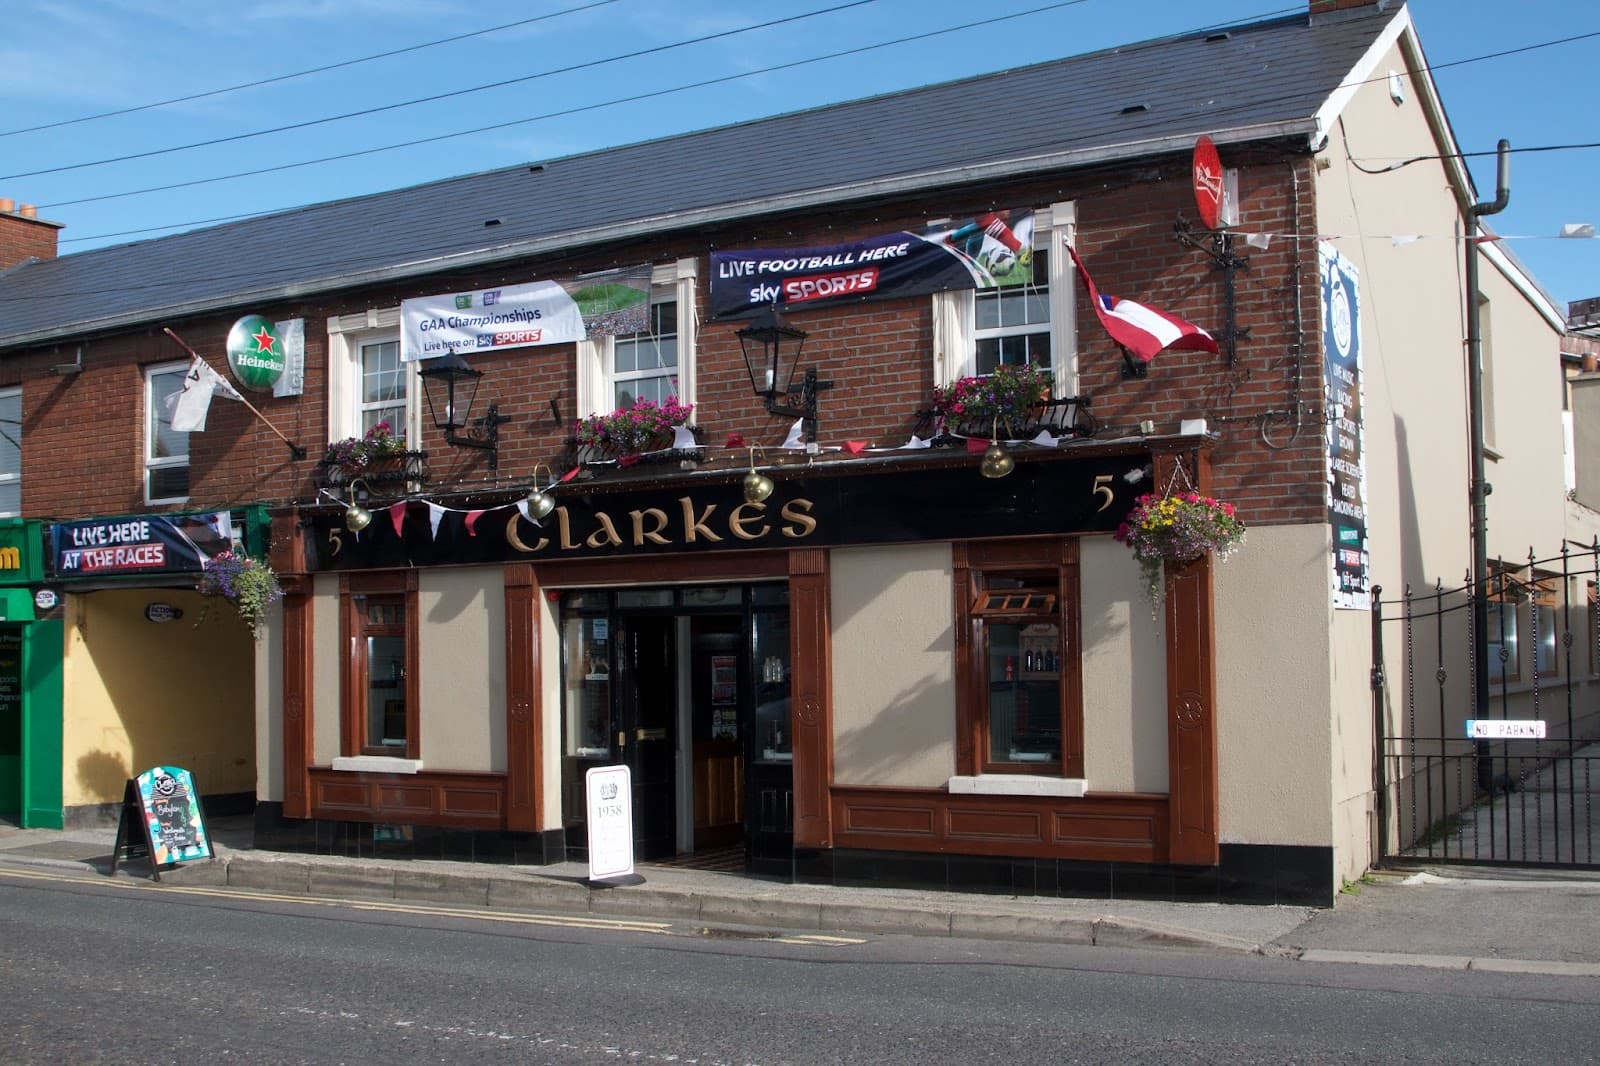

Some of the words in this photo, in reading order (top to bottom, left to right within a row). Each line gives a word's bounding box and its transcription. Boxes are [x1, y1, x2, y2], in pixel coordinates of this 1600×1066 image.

[720, 261, 755, 279] LIVE
[758, 253, 854, 273] FOOTBALL
[858, 243, 910, 262] HERE
[750, 283, 780, 303] sky
[786, 272, 874, 299] SPORTS
[420, 318, 446, 332] GAA
[448, 308, 542, 328] Championships
[424, 343, 441, 352] Live
[442, 339, 461, 349] here
[463, 339, 475, 348] on
[495, 330, 540, 345] SPORTS
[1092, 475, 1114, 512] 5
[73, 525, 107, 546] LIVE
[109, 521, 150, 543] HERE
[329, 528, 342, 557] 5
[63, 552, 81, 570] AT
[84, 550, 113, 568] THE
[116, 546, 164, 565] RACES
[1476, 725, 1488, 736] NO
[1499, 725, 1541, 737] PARKING
